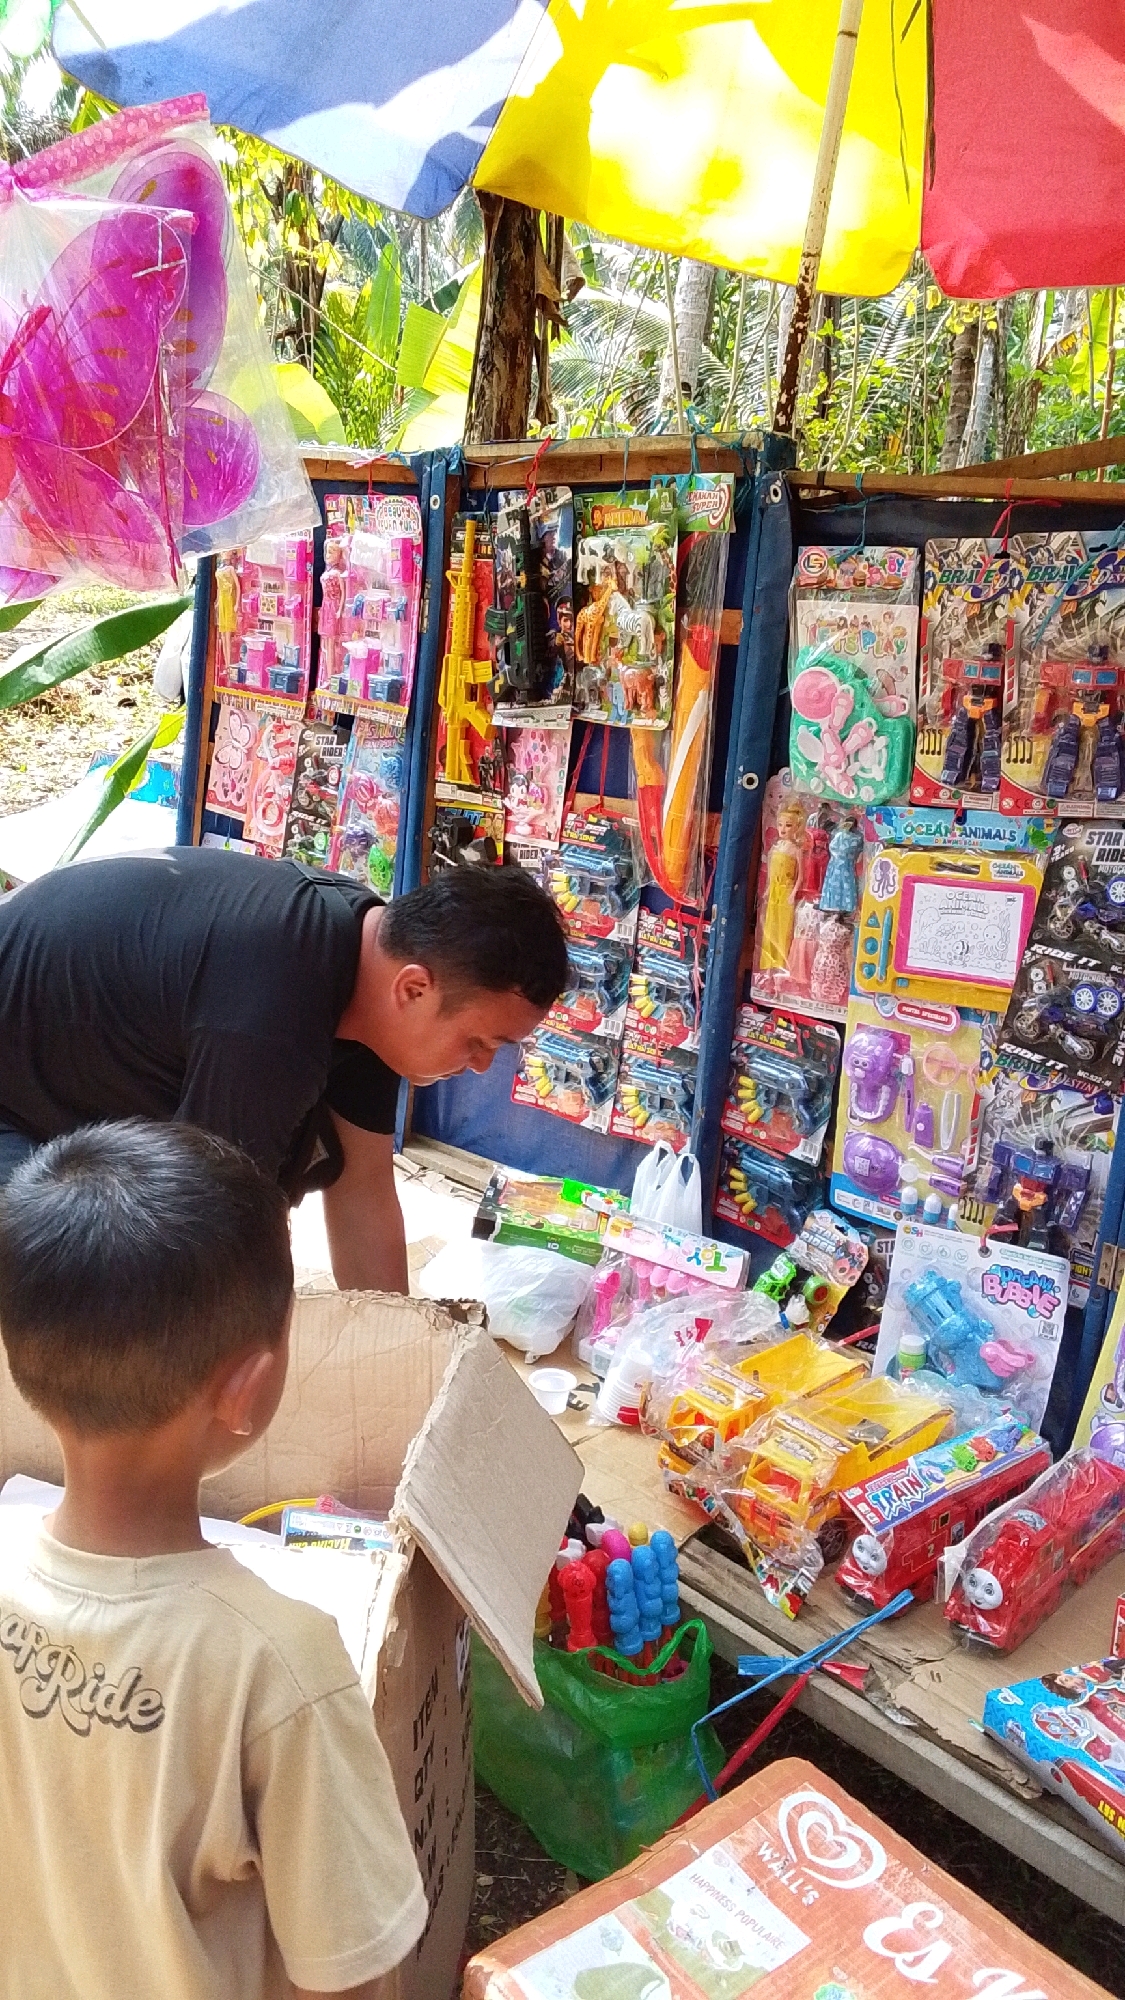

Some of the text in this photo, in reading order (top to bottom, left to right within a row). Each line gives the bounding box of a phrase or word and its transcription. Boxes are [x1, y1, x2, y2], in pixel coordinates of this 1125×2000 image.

[939, 568, 998, 584] BRAVE
[1026, 565, 1093, 584] BRAVE
[315, 735, 335, 746] STAR
[321, 746, 343, 757] RIDER
[903, 822, 1017, 842] OCEAN ANIMALS
[1085, 831, 1124, 846] STAR
[1095, 847, 1125, 862] RIDE
[946, 890, 985, 904] OCEAN
[939, 900, 990, 915] ANIMALS
[1030, 943, 1079, 962] RIDE
[999, 1042, 1047, 1063] RIDE
[999, 1265, 1055, 1291] DREAM
[868, 1471, 929, 1519] TRAIN
[20, 1644, 166, 1738] Ride
[757, 1841, 820, 1907] WALL'S
[688, 1872, 787, 1951] HAPPINESS POPULAIRE
